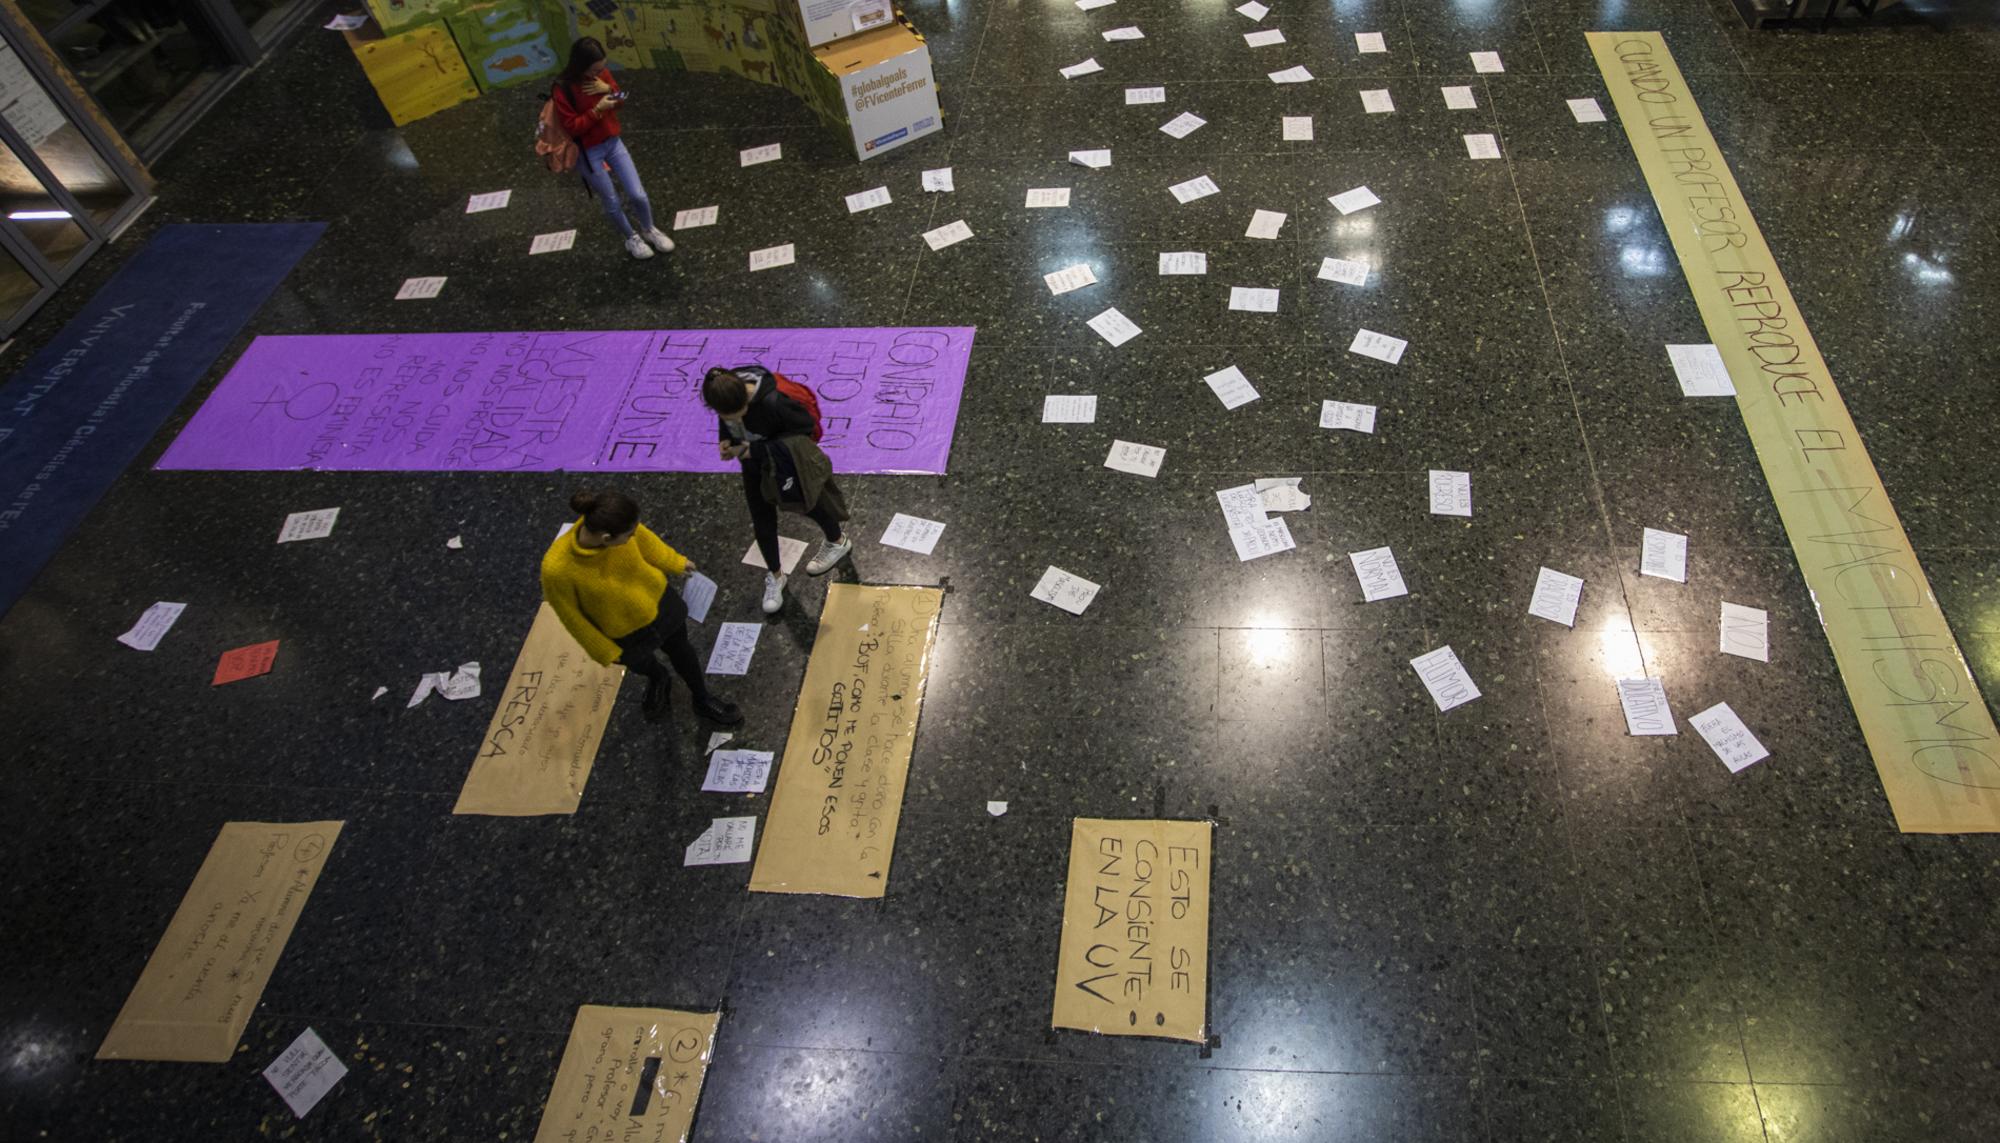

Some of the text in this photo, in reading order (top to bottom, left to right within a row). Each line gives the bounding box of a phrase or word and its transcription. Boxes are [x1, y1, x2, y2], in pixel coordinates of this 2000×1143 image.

[851, 68, 907, 97] #globalgoals
[855, 77, 926, 111] @FVicenteFerrer
[1614, 40, 1677, 103] CUANDO
[1650, 116, 1697, 139] UN
[1661, 148, 1747, 253] PROFESOR
[1716, 272, 1824, 407] REPRODUCE
[354, 368, 383, 389] ES
[609, 336, 708, 462] IMPUNE
[817, 341, 877, 402] FIJO
[866, 331, 950, 450] CONTRATO
[504, 333, 608, 470] VUESTRA
[1795, 429, 1846, 464] EL
[1357, 552, 1389, 599] NORMAL
[1726, 617, 1764, 648] NO
[1417, 652, 1468, 709] HUMOR
[481, 671, 543, 758] FRESCA
[1075, 837, 1122, 1004] EN LA UV
[1168, 847, 1198, 994] ESTO SE
[583, 1074, 596, 1103] pero
[610, 1100, 624, 1120] voy
[604, 1130, 614, 1141] al
